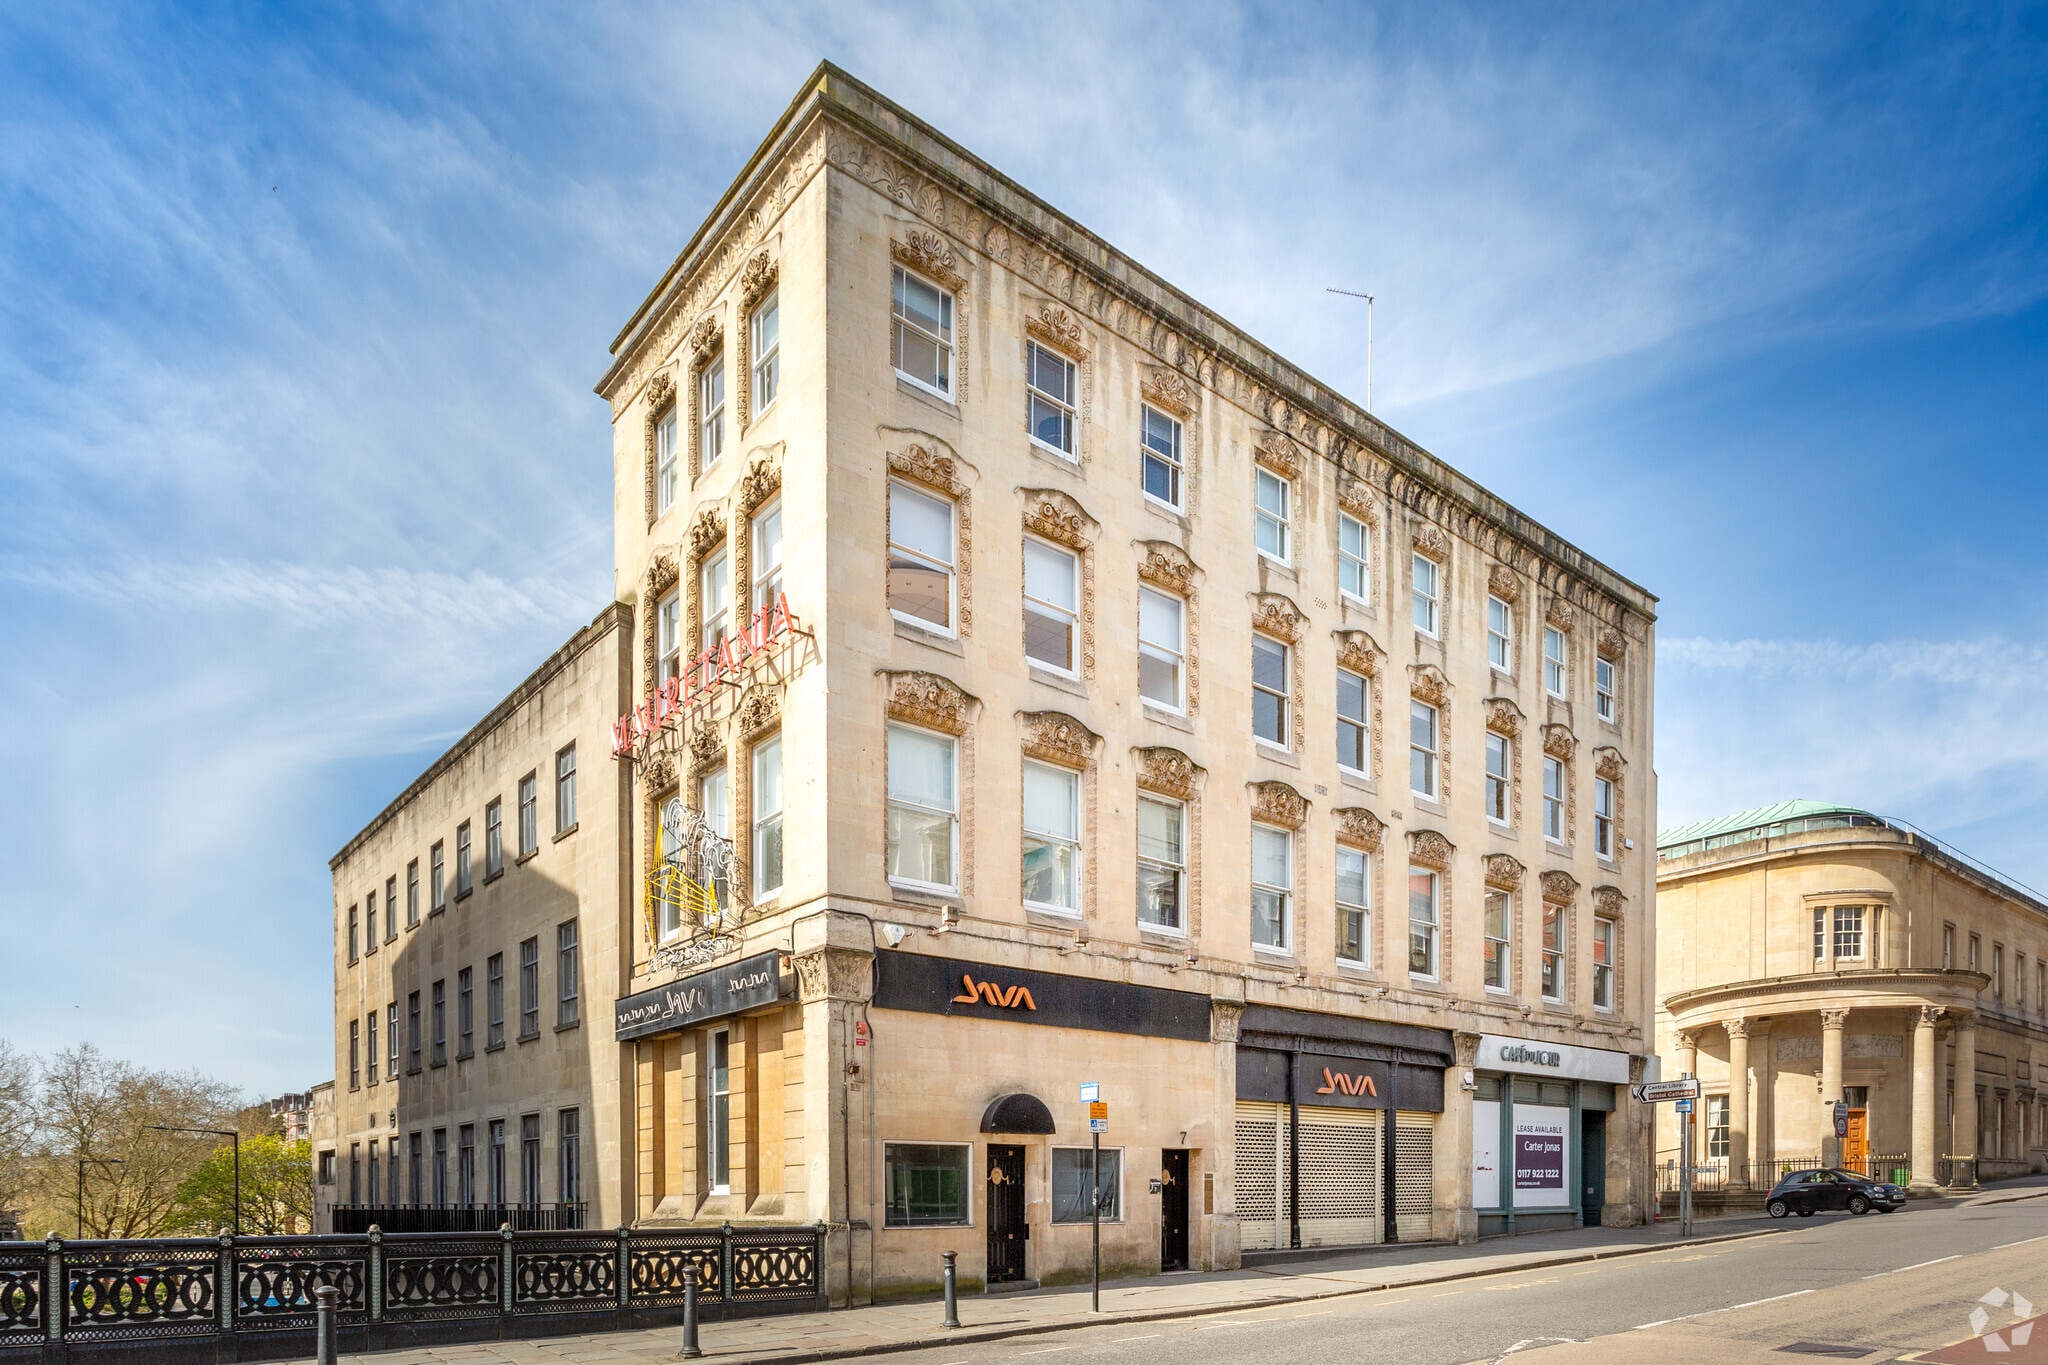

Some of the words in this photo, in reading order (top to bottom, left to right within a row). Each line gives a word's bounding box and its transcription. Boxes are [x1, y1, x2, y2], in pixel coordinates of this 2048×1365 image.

[610, 592, 795, 762] MAURETANIA
[953, 974, 1037, 1011] JAVA
[1316, 1067, 1378, 1097] JAVA
[1516, 1124, 1534, 1133] LEASE
[1534, 1125, 1563, 1134] AVAILABLE
[1179, 1131, 1187, 1145] 7
[1524, 1140, 1544, 1152] Carter
[1543, 1141, 1561, 1154] Jonas
[1517, 1169, 1531, 1178] 0117
[1531, 1169, 1545, 1178] 922
[1545, 1169, 1560, 1178] 1222
